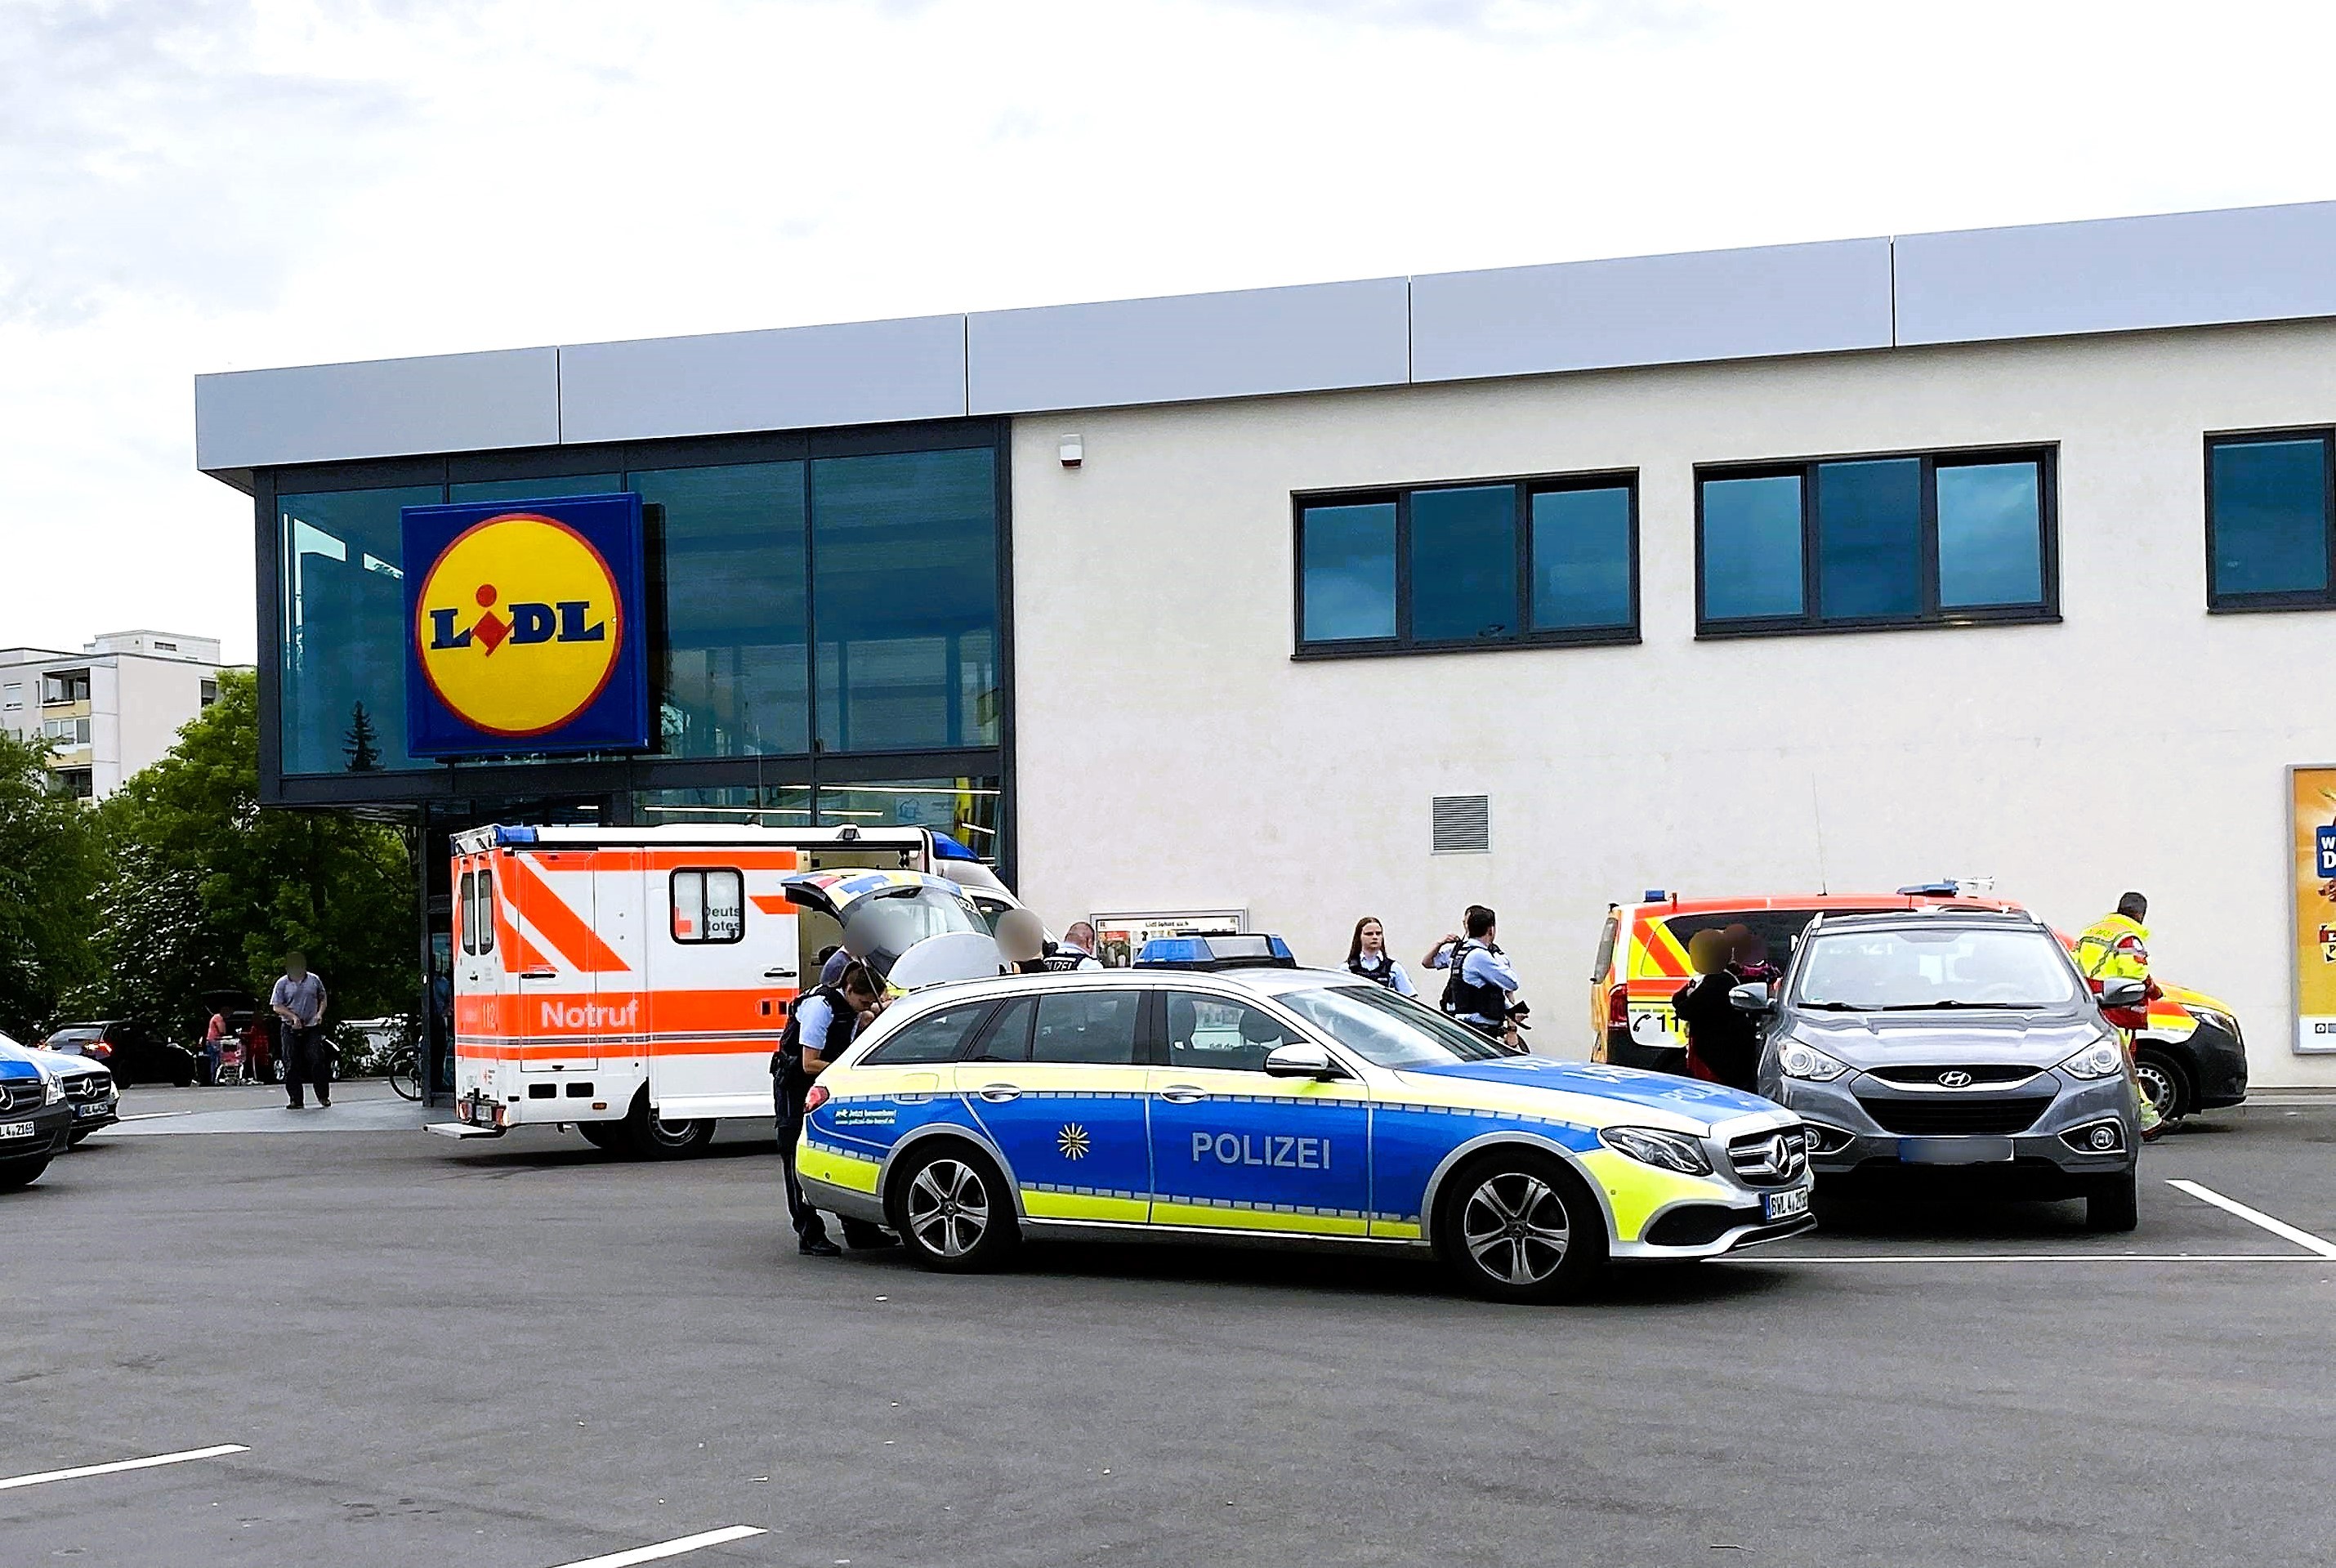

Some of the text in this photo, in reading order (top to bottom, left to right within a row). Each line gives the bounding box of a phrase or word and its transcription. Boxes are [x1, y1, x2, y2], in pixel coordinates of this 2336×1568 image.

[430, 583, 605, 657] LIDL
[2320, 836, 2336, 850] W
[2322, 851, 2336, 869] D
[707, 920, 739, 931] otes
[541, 998, 638, 1028] Notruf
[1656, 1014, 1679, 1032] 11
[1192, 1132, 1330, 1169] POLIZEI
